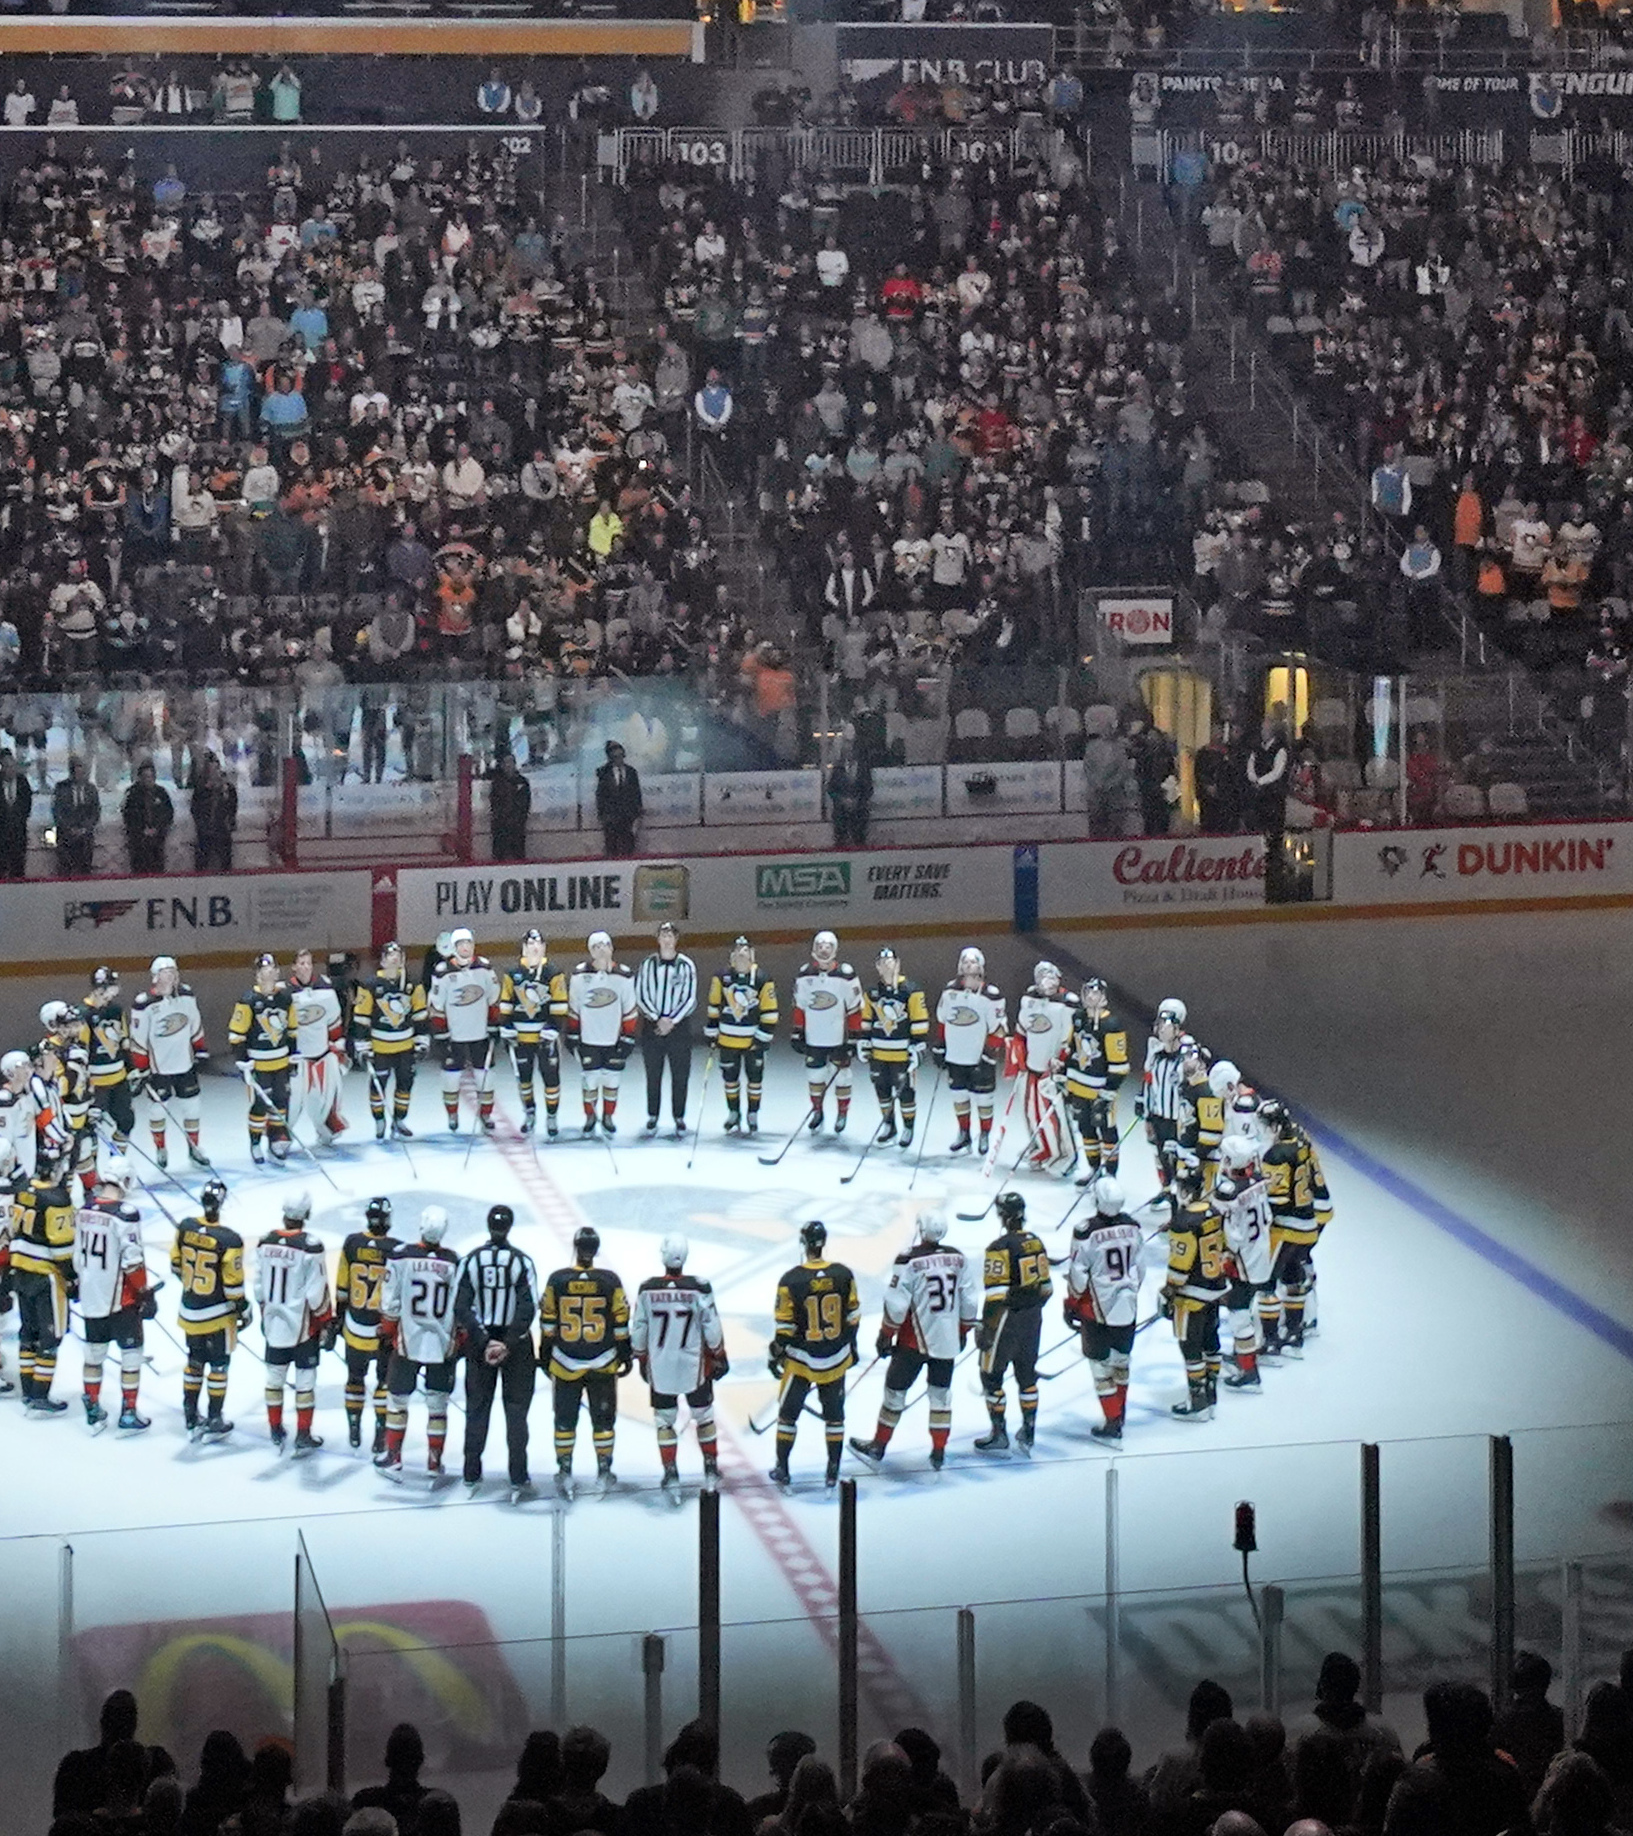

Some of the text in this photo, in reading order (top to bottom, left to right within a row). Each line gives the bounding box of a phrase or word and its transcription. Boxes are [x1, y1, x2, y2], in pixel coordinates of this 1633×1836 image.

[677, 141, 727, 166] 103
[867, 862, 952, 883] EVERY SAVE
[1457, 837, 1614, 877] DUNKIN'
[435, 879, 495, 915] PLAY
[500, 874, 621, 913] ONLINE
[760, 864, 849, 895] MSA
[146, 894, 239, 931] F.N.B.
[180, 1246, 218, 1296] 65
[1105, 1246, 1133, 1282] 91
[269, 1266, 289, 1305] 11
[410, 1280, 449, 1320] 20
[558, 1295, 607, 1343] 55
[652, 1309, 695, 1350] 77
[805, 1293, 842, 1342] 19
